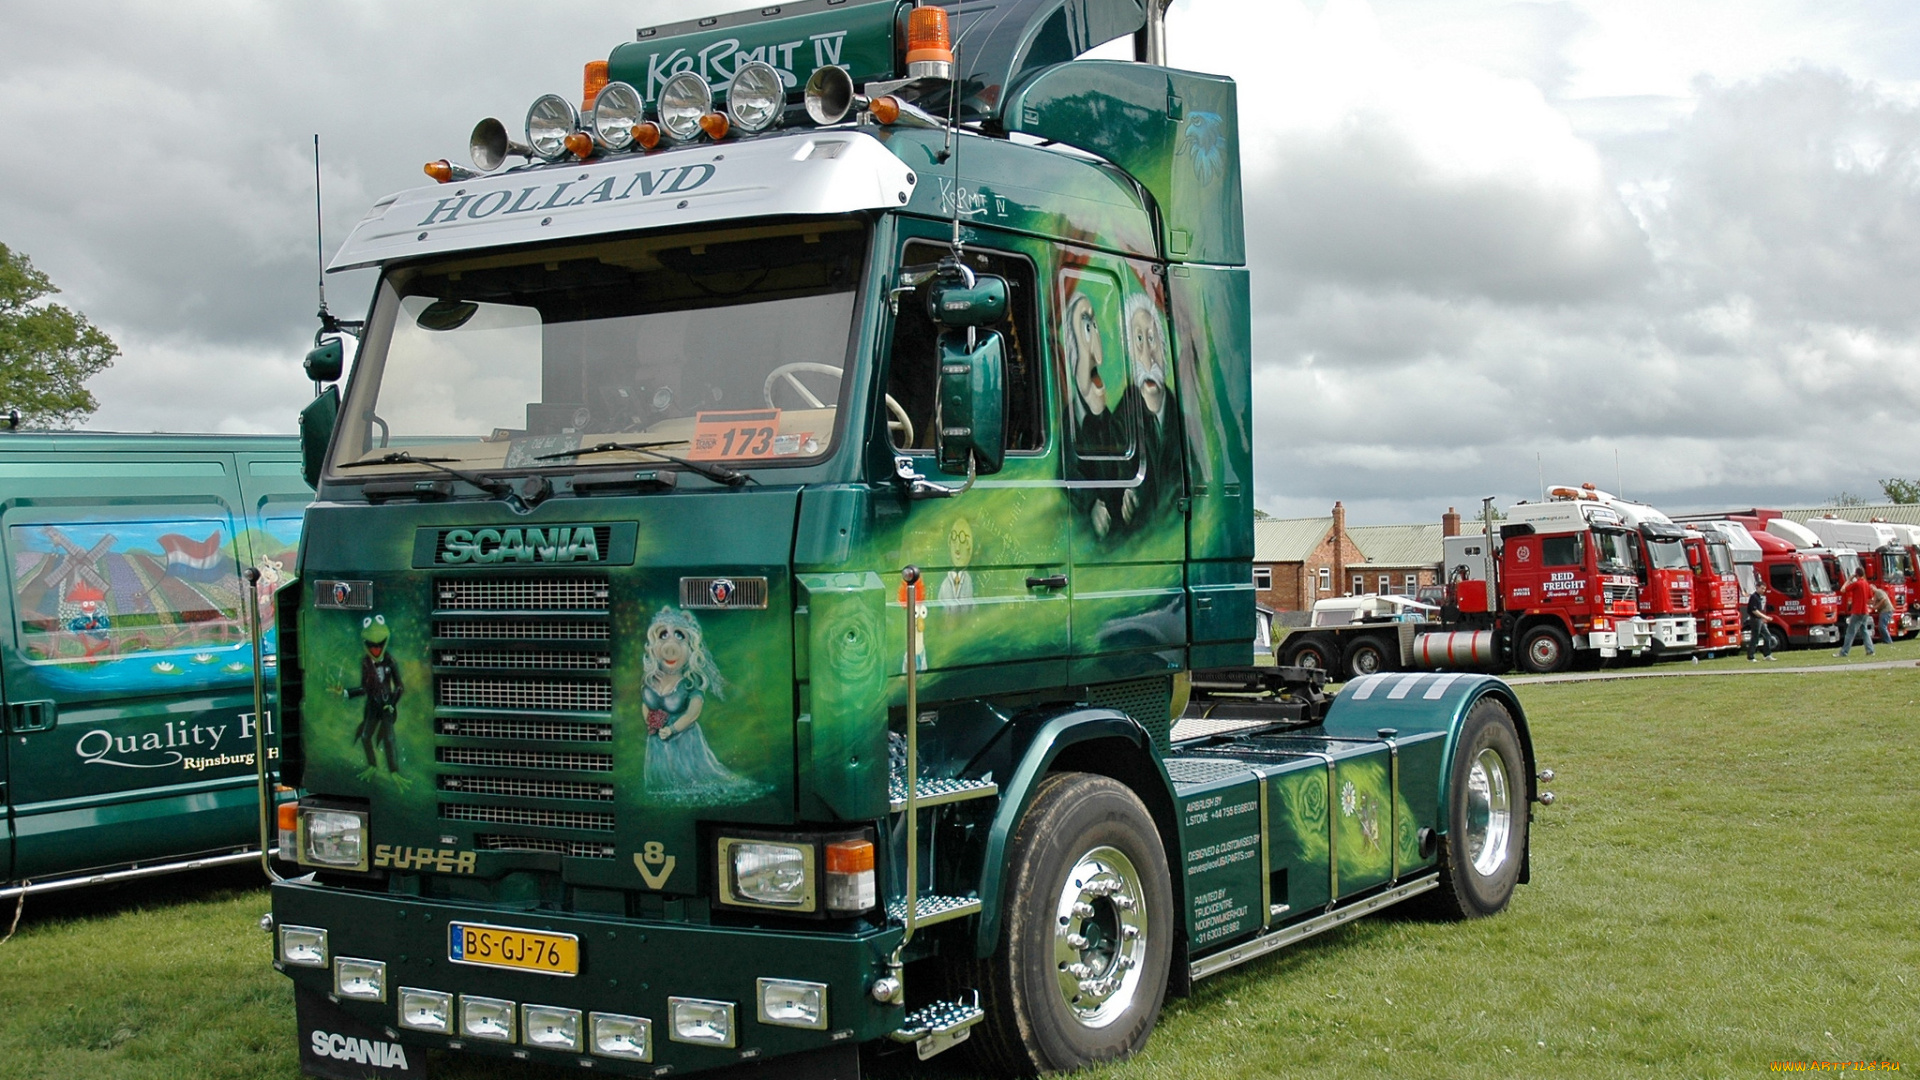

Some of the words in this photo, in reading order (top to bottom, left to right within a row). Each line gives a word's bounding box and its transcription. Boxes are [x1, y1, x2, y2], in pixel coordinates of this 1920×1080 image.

[809, 30, 850, 70] IV
[417, 163, 716, 226] HOLLAND
[721, 427, 774, 456] 173
[441, 527, 600, 563] SCANIA
[1543, 581, 1586, 591] FREIGHT
[1551, 572, 1574, 581] REID
[76, 720, 227, 769] Quality
[183, 752, 255, 771] Rijnsburg
[1186, 798, 1214, 813] AIRBRUSH
[1215, 796, 1222, 806] BY
[374, 844, 477, 874] SUPER
[1188, 846, 1215, 861] DESIGNED
[1221, 836, 1253, 853] CUSTOMISED
[1194, 891, 1218, 906] PAINTED
[1218, 888, 1226, 899] BY
[466, 930, 560, 965] BS-GJ-76
[311, 1030, 409, 1070] SCANIA
